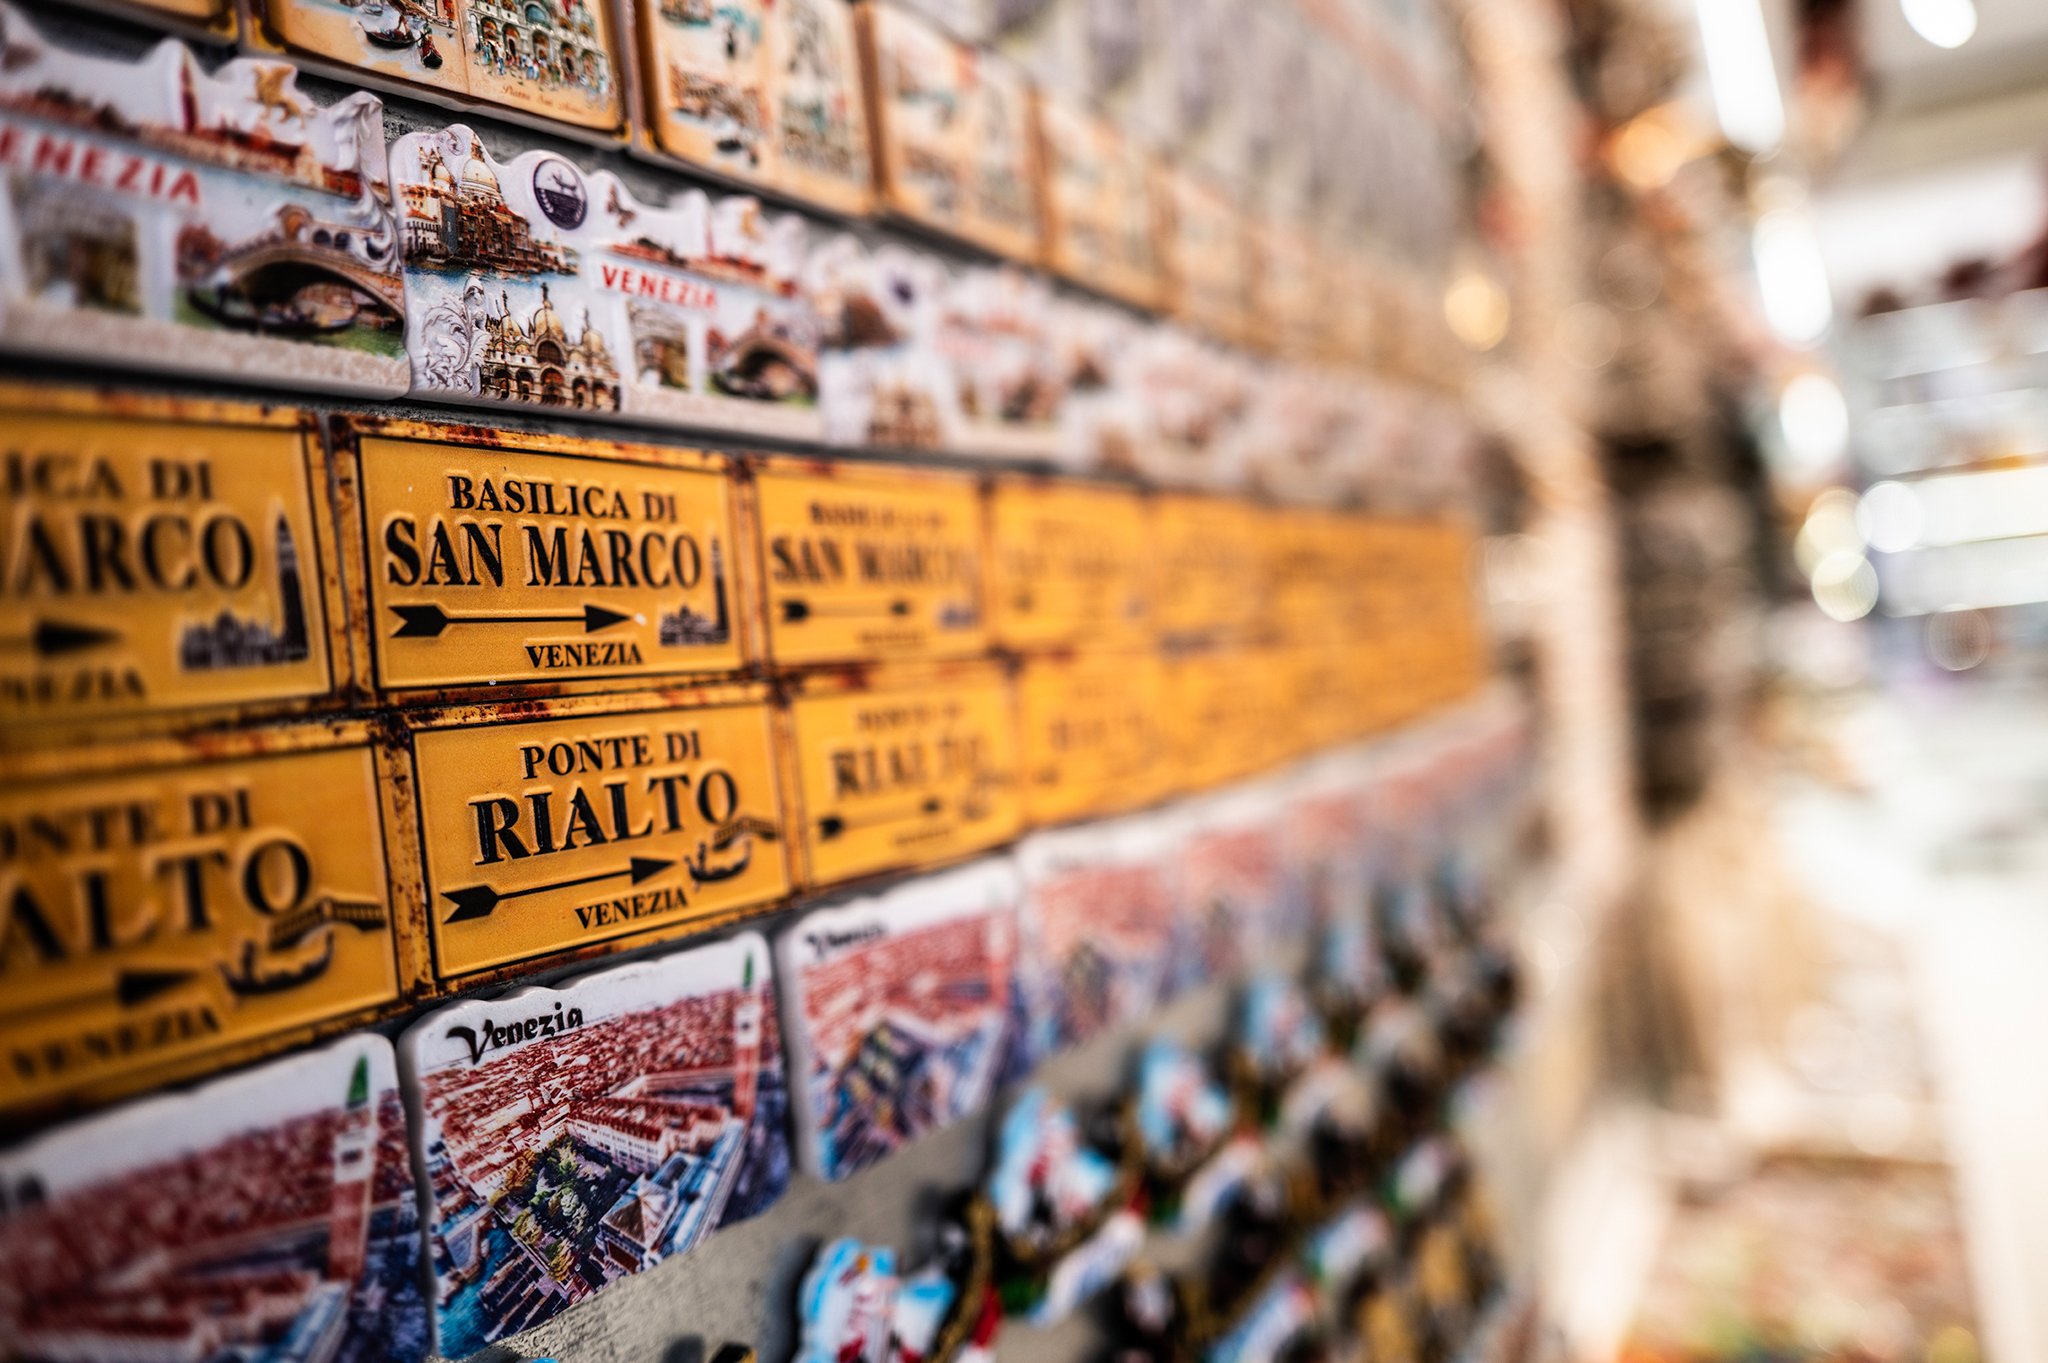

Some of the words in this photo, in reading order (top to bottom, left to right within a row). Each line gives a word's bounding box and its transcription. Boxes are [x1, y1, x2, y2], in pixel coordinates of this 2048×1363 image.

[602, 264, 717, 310] VENEZIA
[149, 458, 211, 500] DI
[448, 475, 631, 521] BASILICA
[642, 491, 678, 523] DI
[0, 512, 253, 592] ARCO
[385, 517, 503, 588] SAN
[523, 525, 702, 590] MARCO
[525, 642, 644, 669] VENEZIA
[520, 735, 654, 779] PONTE
[664, 729, 701, 763] DI
[189, 787, 252, 835] DI
[468, 769, 738, 866] RIALTO
[575, 886, 688, 930] VENEZIA
[446, 1001, 584, 1065] Venezia
